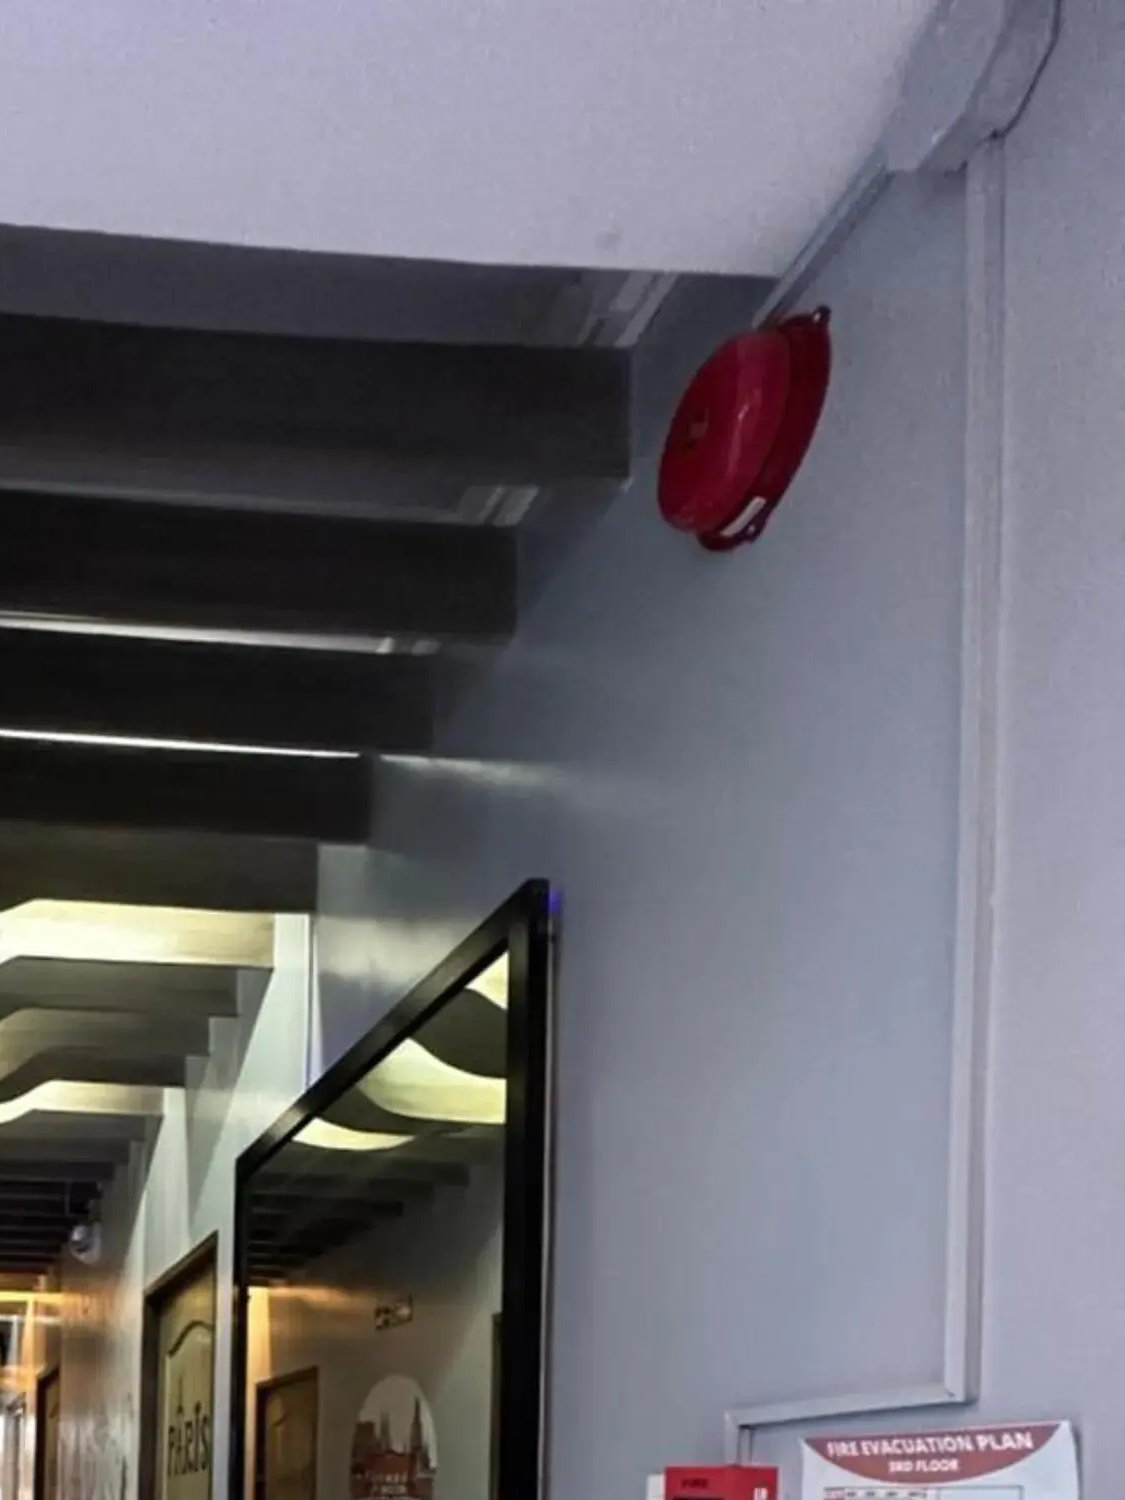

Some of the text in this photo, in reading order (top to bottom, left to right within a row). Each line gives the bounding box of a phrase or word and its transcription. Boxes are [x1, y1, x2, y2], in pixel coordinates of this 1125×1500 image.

[827, 1432, 1034, 1458] FIRE EVACUATION PLAN
[916, 1459, 960, 1473] FLOOR
